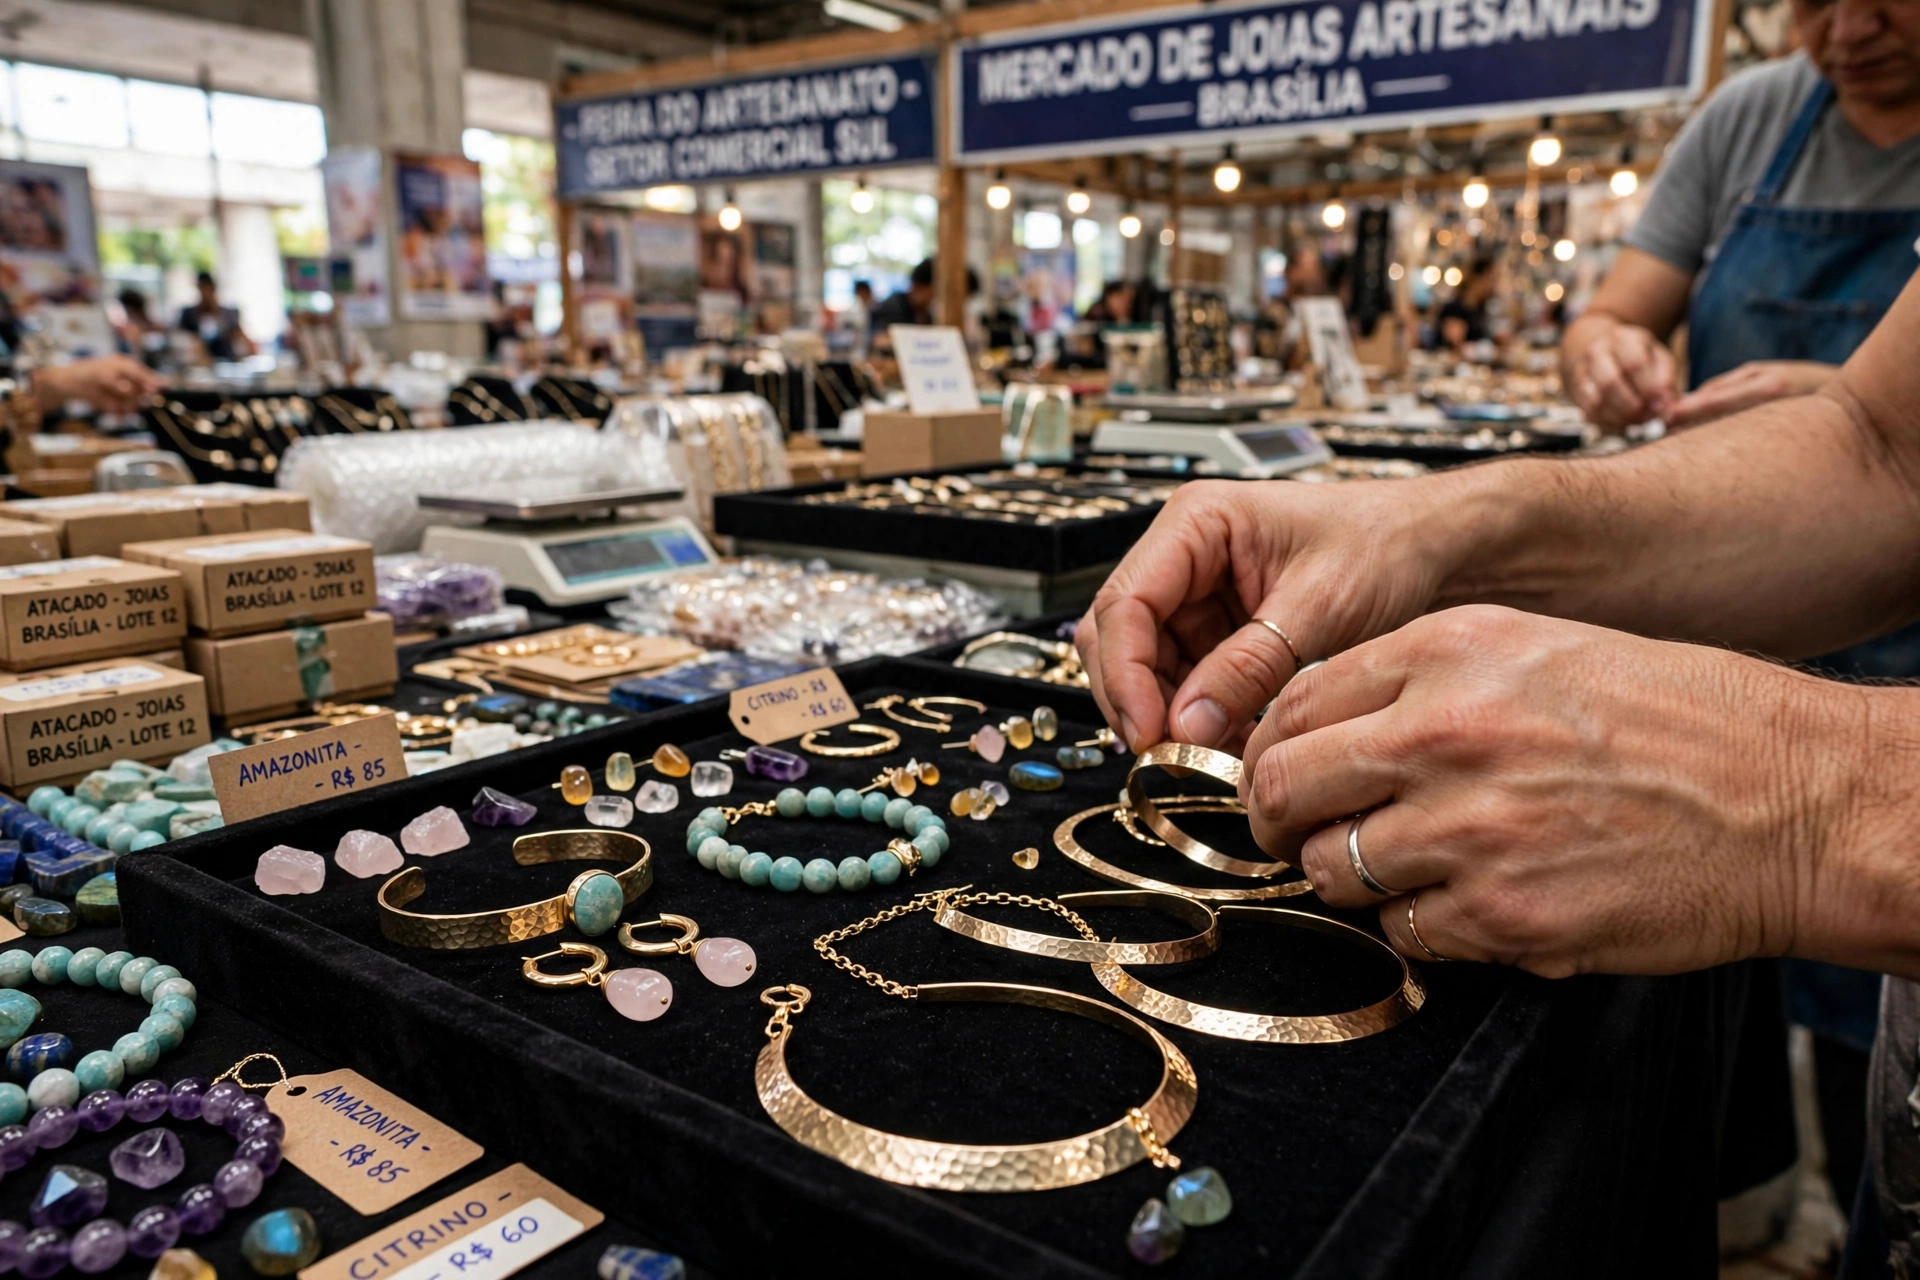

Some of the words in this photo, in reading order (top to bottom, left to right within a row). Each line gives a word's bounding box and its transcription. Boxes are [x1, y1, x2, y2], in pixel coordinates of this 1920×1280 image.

[979, 33, 1151, 104] MERCADO
[1158, 24, 1215, 84] DE
[1218, 6, 1343, 76] JOIAS
[1196, 63, 1368, 128] BRASÍLIA
[226, 587, 295, 611] BRASÍLIA
[310, 582, 346, 601] LOTE
[351, 580, 365, 595] 12
[228, 566, 296, 587] ATACADO
[314, 559, 356, 577] JOIAS
[27, 593, 107, 618] ATACADO
[125, 585, 169, 606] JOIAS
[22, 615, 101, 644] BRASÍLIA
[117, 611, 156, 629] LOTE
[161, 608, 178, 624] 12
[29, 707, 117, 739] ATACADO
[136, 695, 185, 719] JOIAS
[27, 734, 112, 768] BRASÍLIA
[130, 725, 172, 746] LOTE
[178, 718, 196, 736] 12
[239, 740, 347, 786] AMAZONITA
[331, 767, 356, 789] R$
[363, 758, 386, 782] 85
[312, 1085, 421, 1149] AMAZONITA
[339, 1144, 377, 1169] R$
[366, 1160, 410, 1184] 85
[349, 1202, 488, 1280] CITRINO
[448, 1242, 494, 1272] R$
[501, 1215, 539, 1244] 60
